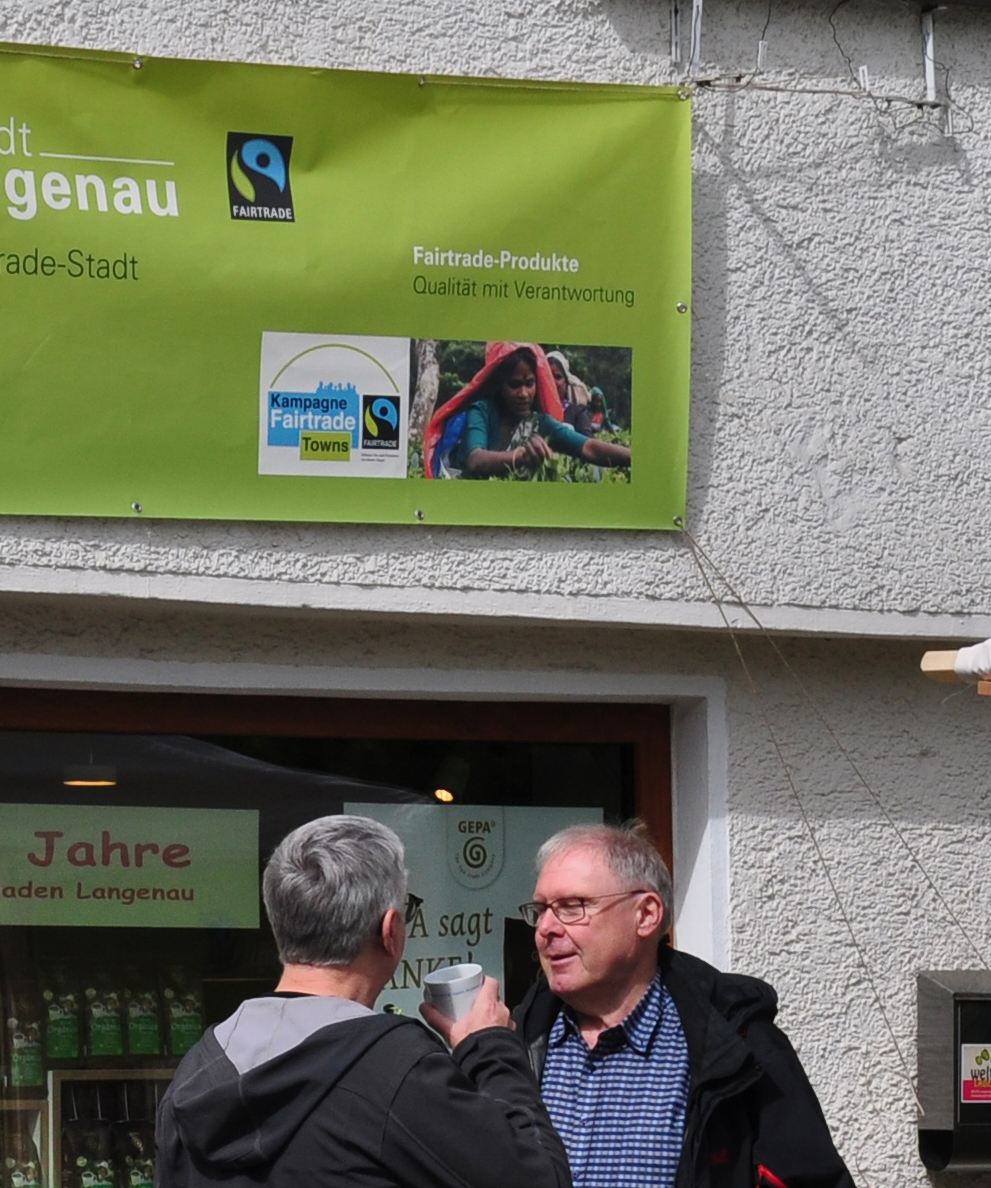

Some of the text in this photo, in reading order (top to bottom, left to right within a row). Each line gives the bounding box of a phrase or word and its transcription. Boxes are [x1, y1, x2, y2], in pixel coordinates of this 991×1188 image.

[232, 204, 293, 220] FAIRTRADE
[412, 245, 580, 273] Fairtrade-Produkte
[412, 275, 636, 308] Qualität mit Verantwortung
[270, 393, 348, 413] Kampagne
[270, 408, 357, 431] Fairtrade
[301, 436, 350, 453] Towns
[26, 830, 192, 869] Jahre
[76, 882, 195, 905] Langenau
[437, 907, 494, 947] sagt
[970, 1065, 991, 1081] wel
